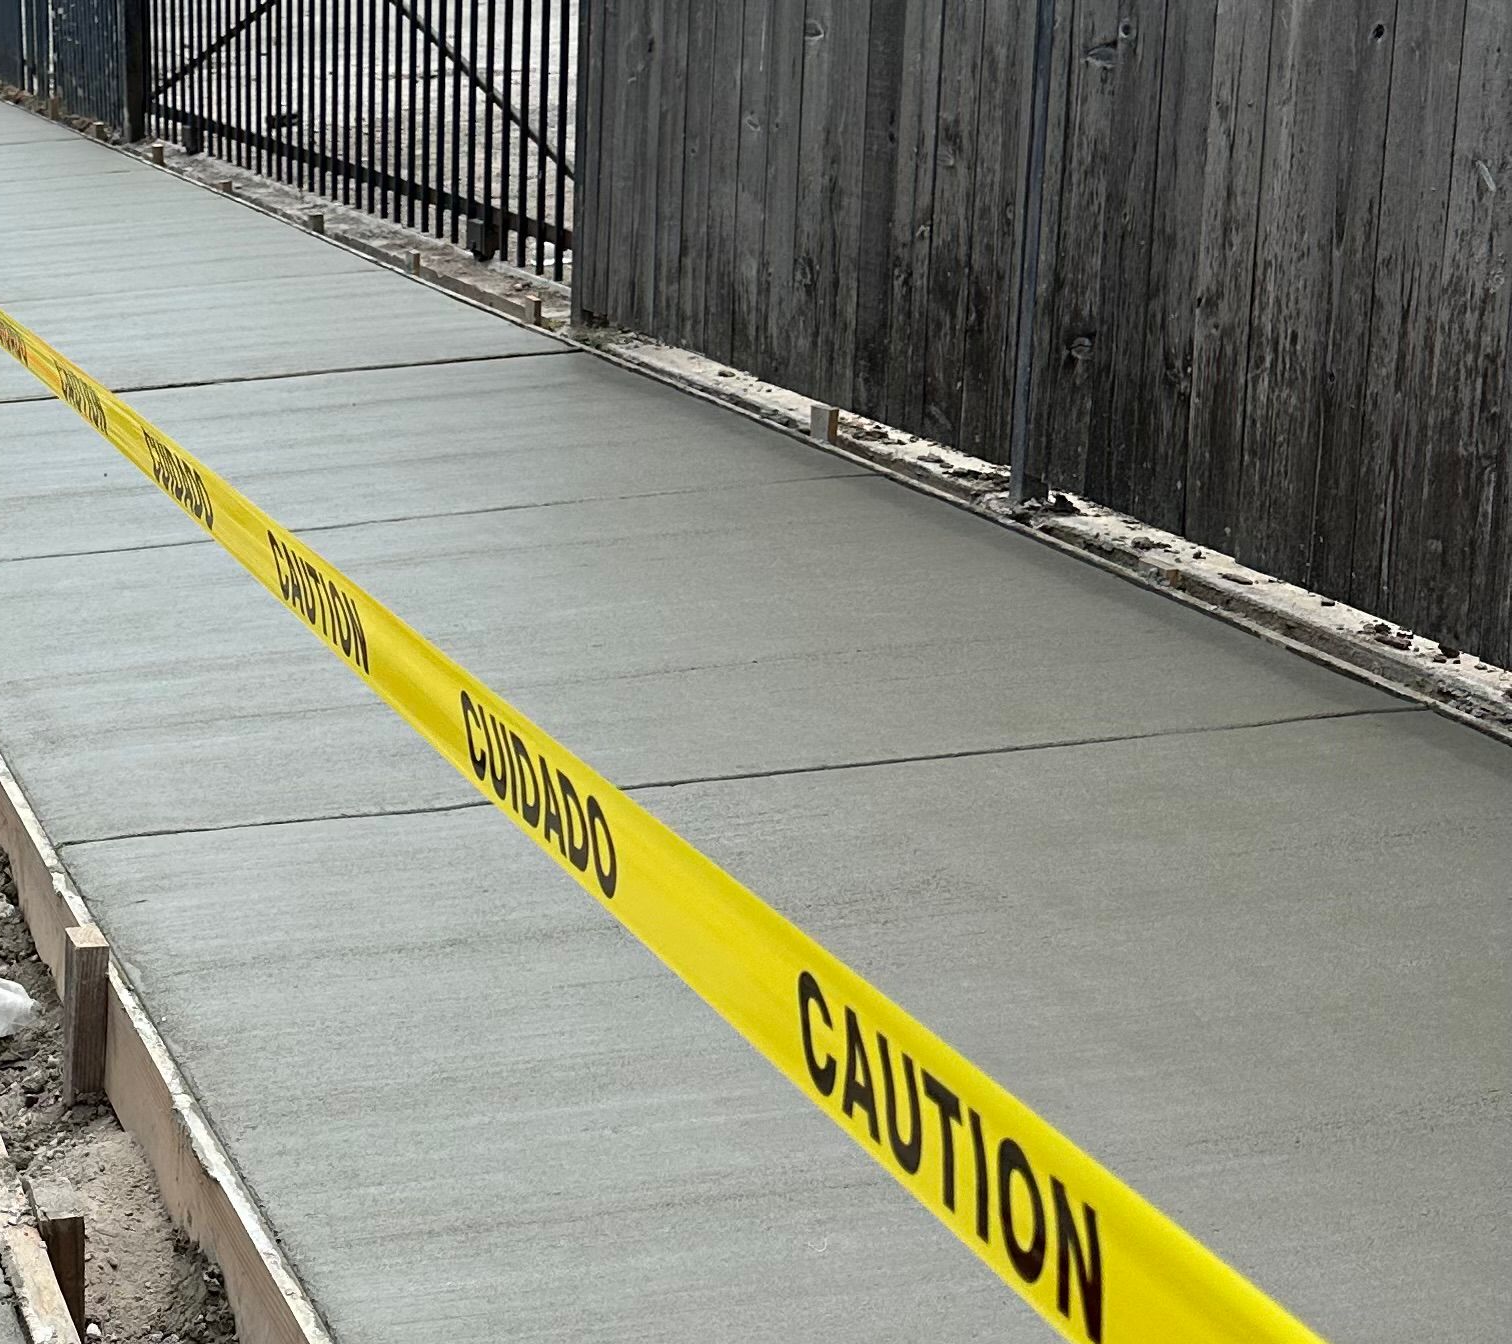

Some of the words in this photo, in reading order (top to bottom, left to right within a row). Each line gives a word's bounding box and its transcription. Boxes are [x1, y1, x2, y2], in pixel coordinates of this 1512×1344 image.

[140, 423, 215, 531] CUIDADO
[267, 529, 370, 675] CAUTION
[460, 690, 618, 899] CUIDADO
